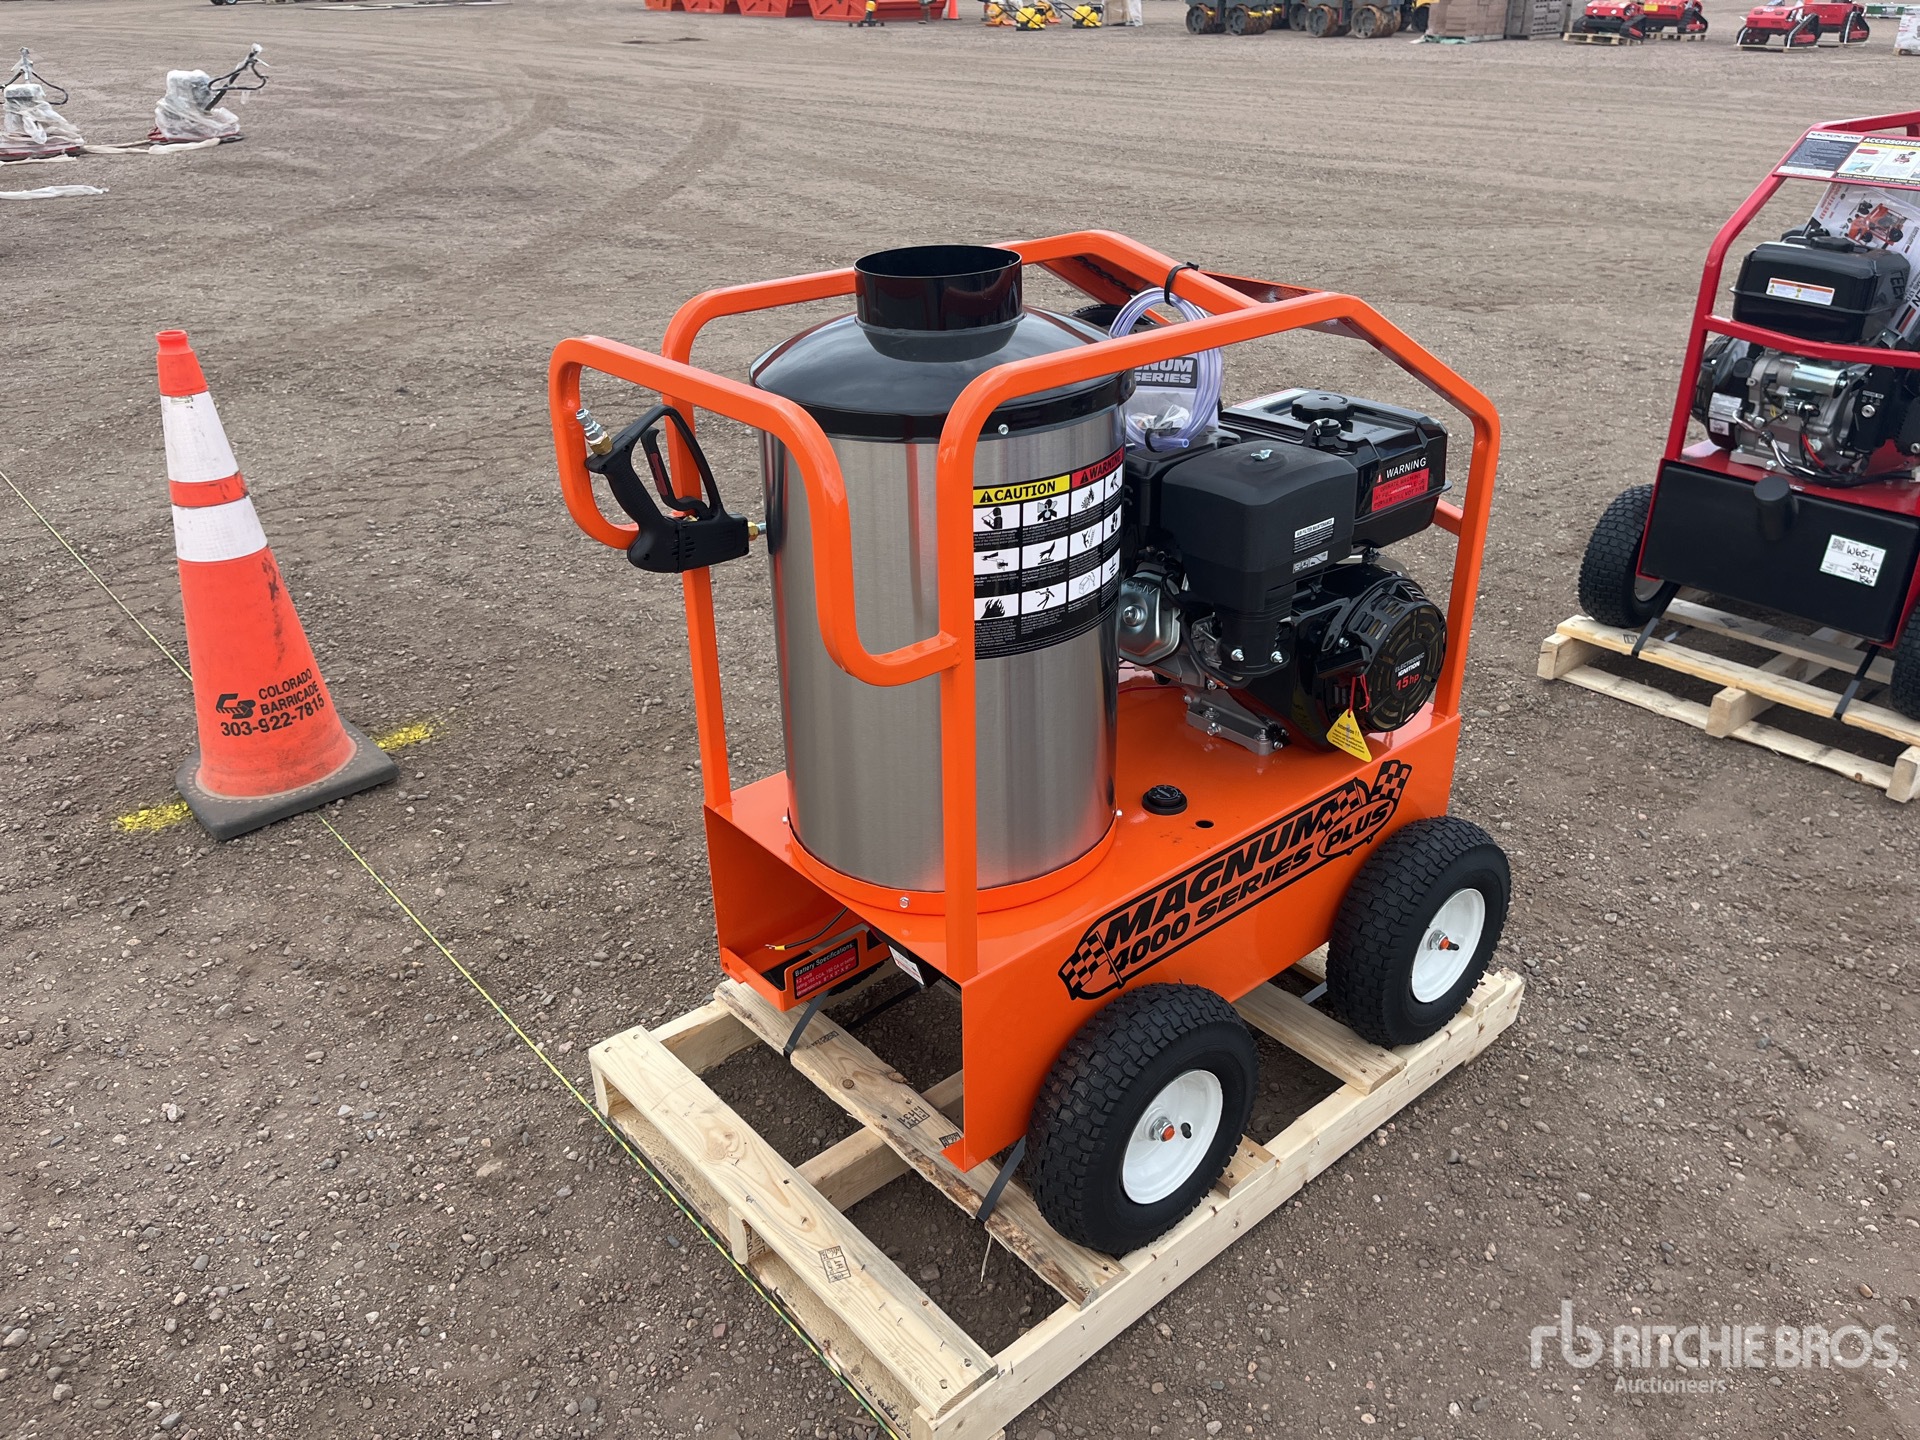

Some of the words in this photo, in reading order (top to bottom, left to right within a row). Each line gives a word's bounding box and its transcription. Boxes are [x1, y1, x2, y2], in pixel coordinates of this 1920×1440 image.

[1134, 358, 1194, 372] NUM
[1134, 372, 1192, 384] SERIES
[1090, 452, 1122, 480] WARNING
[1386, 457, 1427, 478] WARNING
[994, 480, 1056, 502] CAUTION
[258, 668, 312, 700] COLORADO
[260, 681, 320, 716] BARRICADE
[220, 693, 325, 736] 303-922-7815
[1325, 804, 1392, 854] PLUS
[1102, 794, 1338, 949] MAGNUM
[1113, 913, 1190, 974] 4000
[1194, 844, 1316, 926] SERIES
[794, 963, 815, 977] Battery
